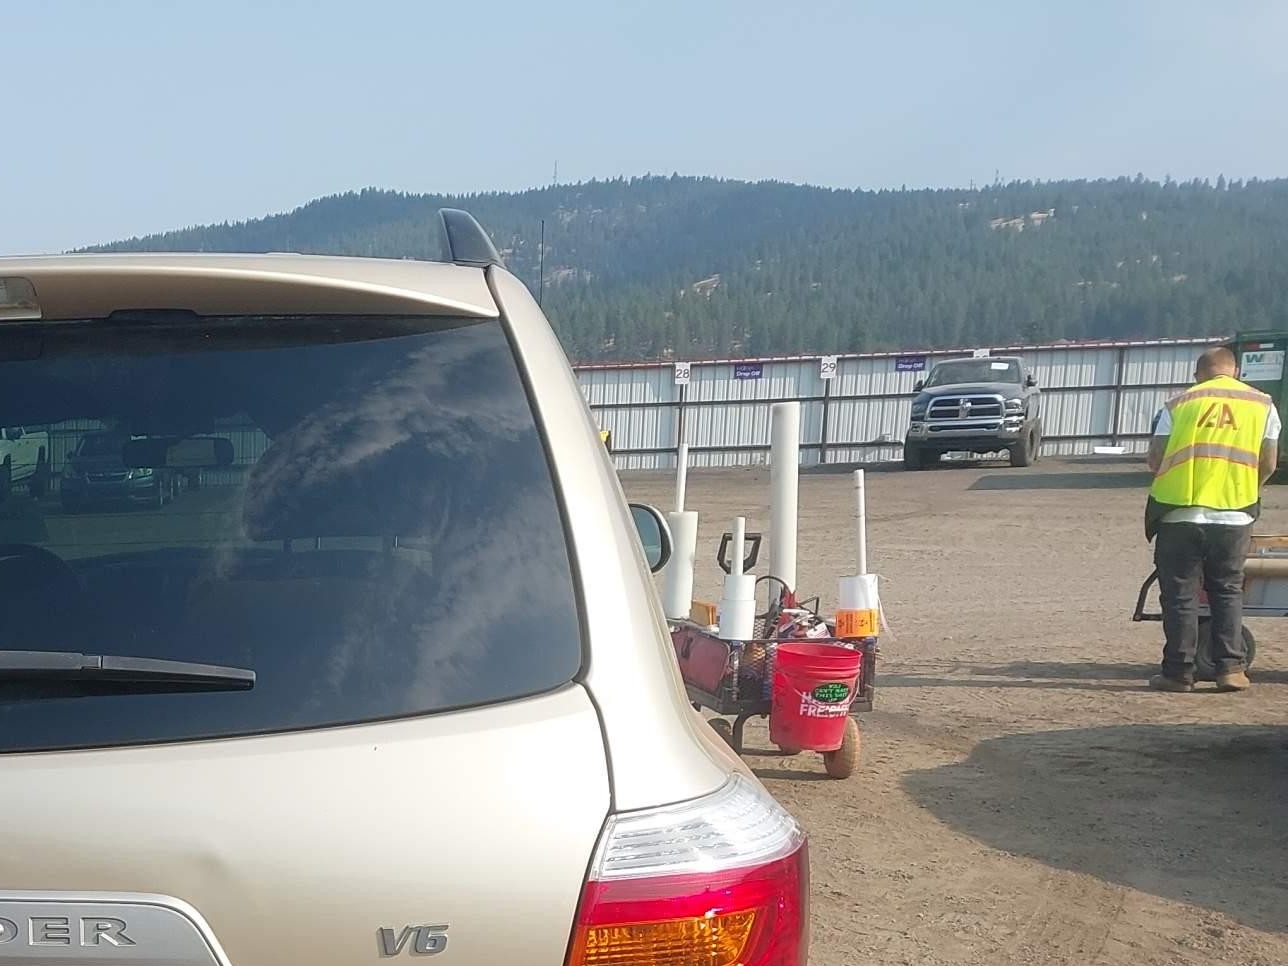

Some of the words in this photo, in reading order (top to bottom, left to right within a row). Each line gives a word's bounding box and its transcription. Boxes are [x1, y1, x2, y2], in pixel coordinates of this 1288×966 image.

[822, 363, 836, 373] 29
[676, 369, 690, 378] 28
[376, 924, 450, 958] V6
